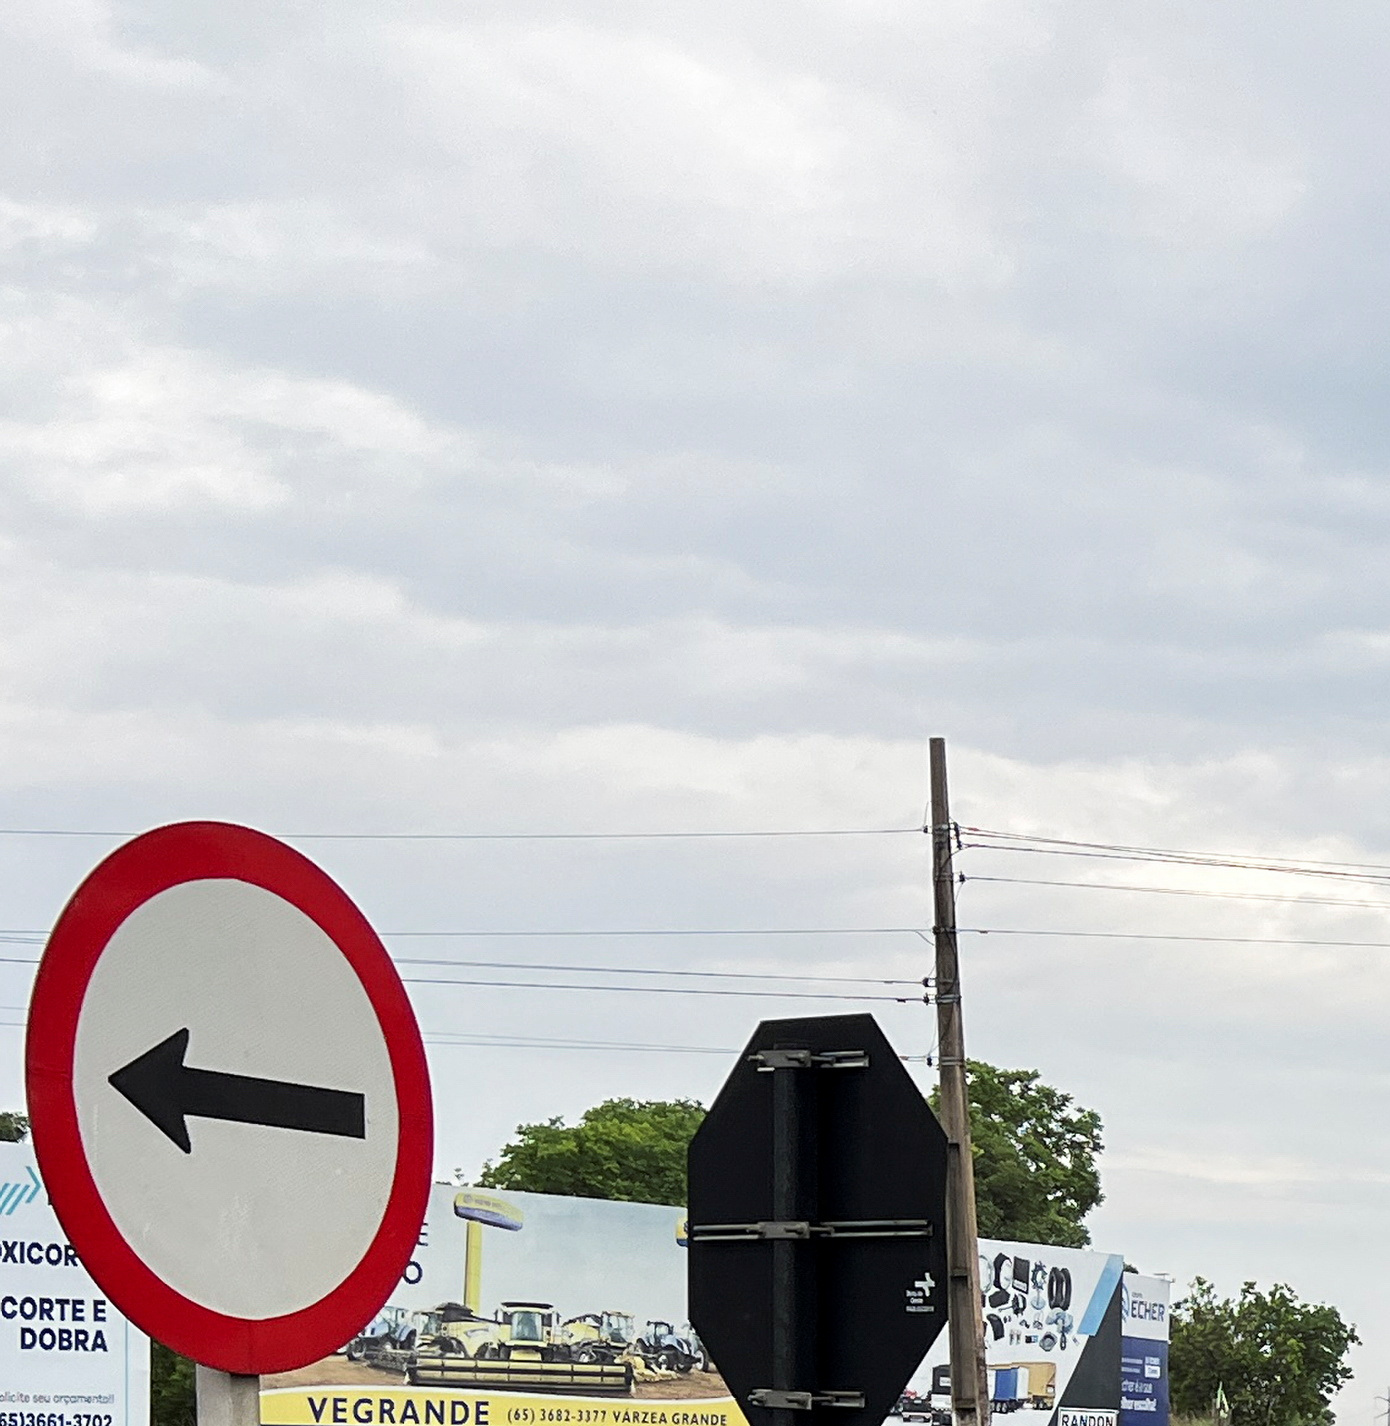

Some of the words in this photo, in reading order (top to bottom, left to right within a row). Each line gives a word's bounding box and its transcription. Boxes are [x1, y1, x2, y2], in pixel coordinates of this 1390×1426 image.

[0, 1295, 85, 1322] CORTE
[93, 1299, 107, 1322] E
[1131, 1300, 1165, 1322] ECHER
[20, 1327, 108, 1352] DOBRA
[307, 1397, 490, 1426] VEGRANDE
[507, 1407, 536, 1425] (65)
[540, 1408, 607, 1424] 3682-3377
[612, 1406, 667, 1425] VÁRZEA
[672, 1412, 728, 1426] GRANDE
